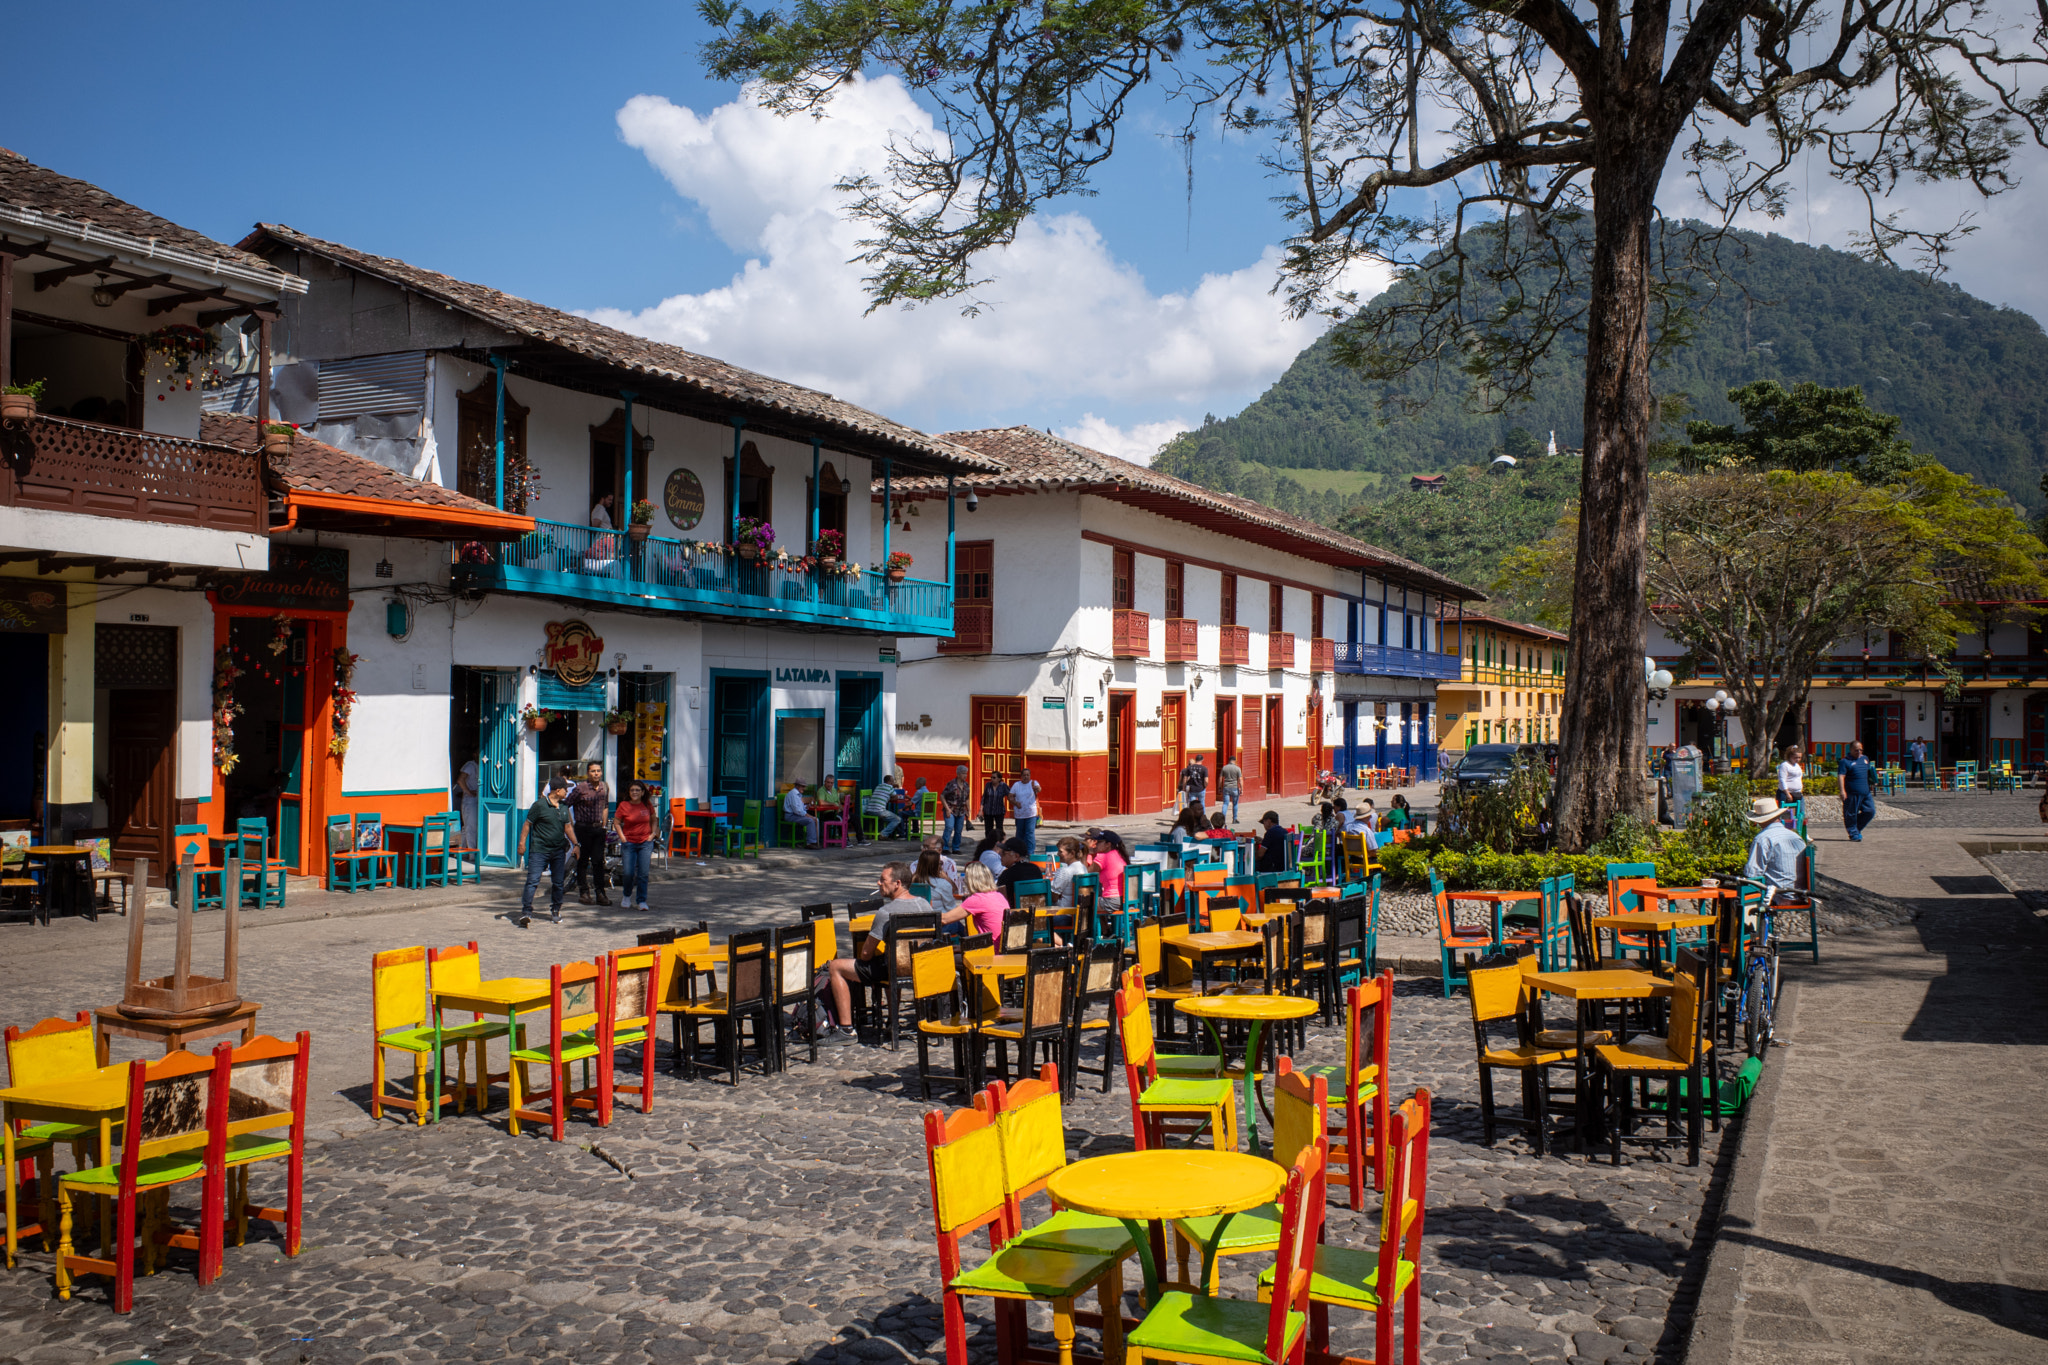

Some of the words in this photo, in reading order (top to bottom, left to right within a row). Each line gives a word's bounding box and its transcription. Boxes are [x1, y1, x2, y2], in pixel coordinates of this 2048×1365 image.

[667, 482, 703, 512] Emma
[221, 576, 340, 601] Juanchito
[1082, 717, 1098, 730] Cajero
